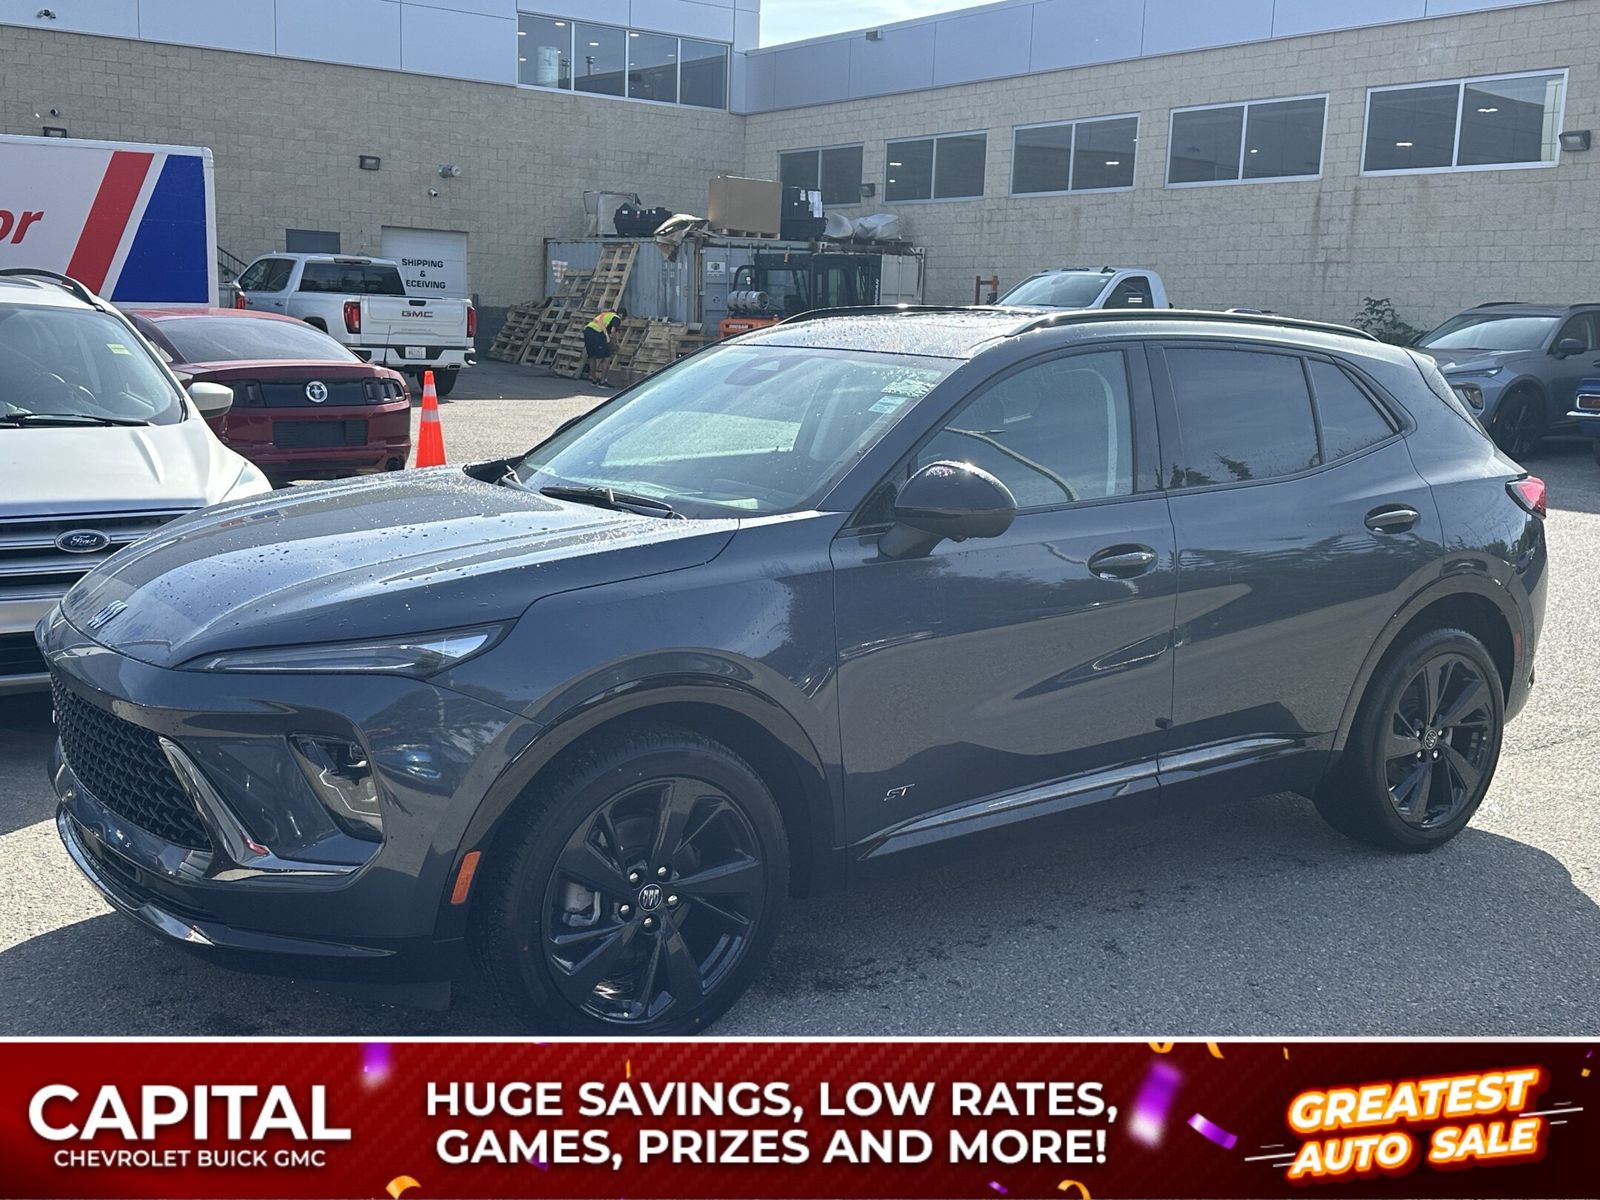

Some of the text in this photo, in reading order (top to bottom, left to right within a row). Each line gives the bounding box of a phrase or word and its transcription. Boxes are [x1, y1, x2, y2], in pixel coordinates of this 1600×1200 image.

[402, 259, 444, 268] SHIPPING
[420, 270, 426, 278] &
[405, 280, 446, 289] ECEIVING
[70, 535, 97, 546] Ford
[884, 784, 915, 801] ST
